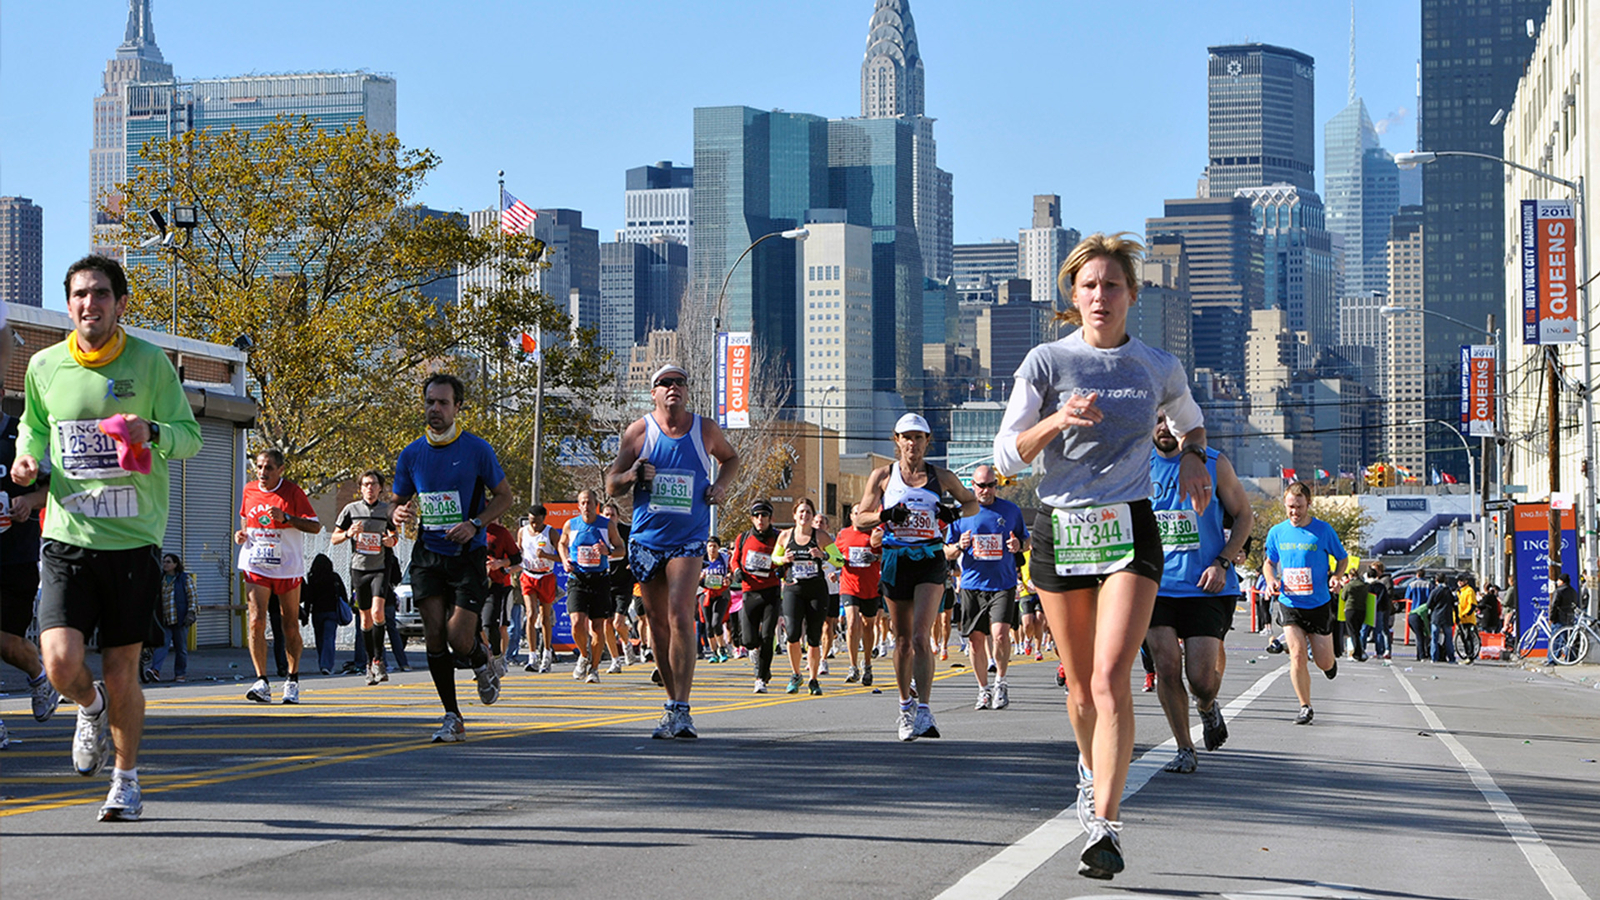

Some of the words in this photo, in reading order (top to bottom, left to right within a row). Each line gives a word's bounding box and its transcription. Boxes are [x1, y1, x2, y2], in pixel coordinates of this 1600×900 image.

[1541, 208, 1571, 217] 2011
[1523, 205, 1535, 247] MARATHON
[1524, 249, 1535, 267] CITY
[1548, 222, 1568, 314] QUEENS
[1524, 268, 1536, 289] YORK
[1525, 290, 1536, 308] NEW
[1526, 324, 1536, 339] THE
[732, 348, 745, 409] QUEENS
[1106, 389, 1122, 398] TO
[1123, 389, 1148, 399] RUN
[1476, 360, 1488, 418] QUEENS
[70, 425, 96, 434] ING
[656, 483, 687, 497] 19-631
[76, 488, 134, 517] MATT
[423, 500, 457, 515] 20-048
[1068, 511, 1097, 523] ING
[1065, 520, 1123, 546] 17-344
[1523, 540, 1549, 550] ING
